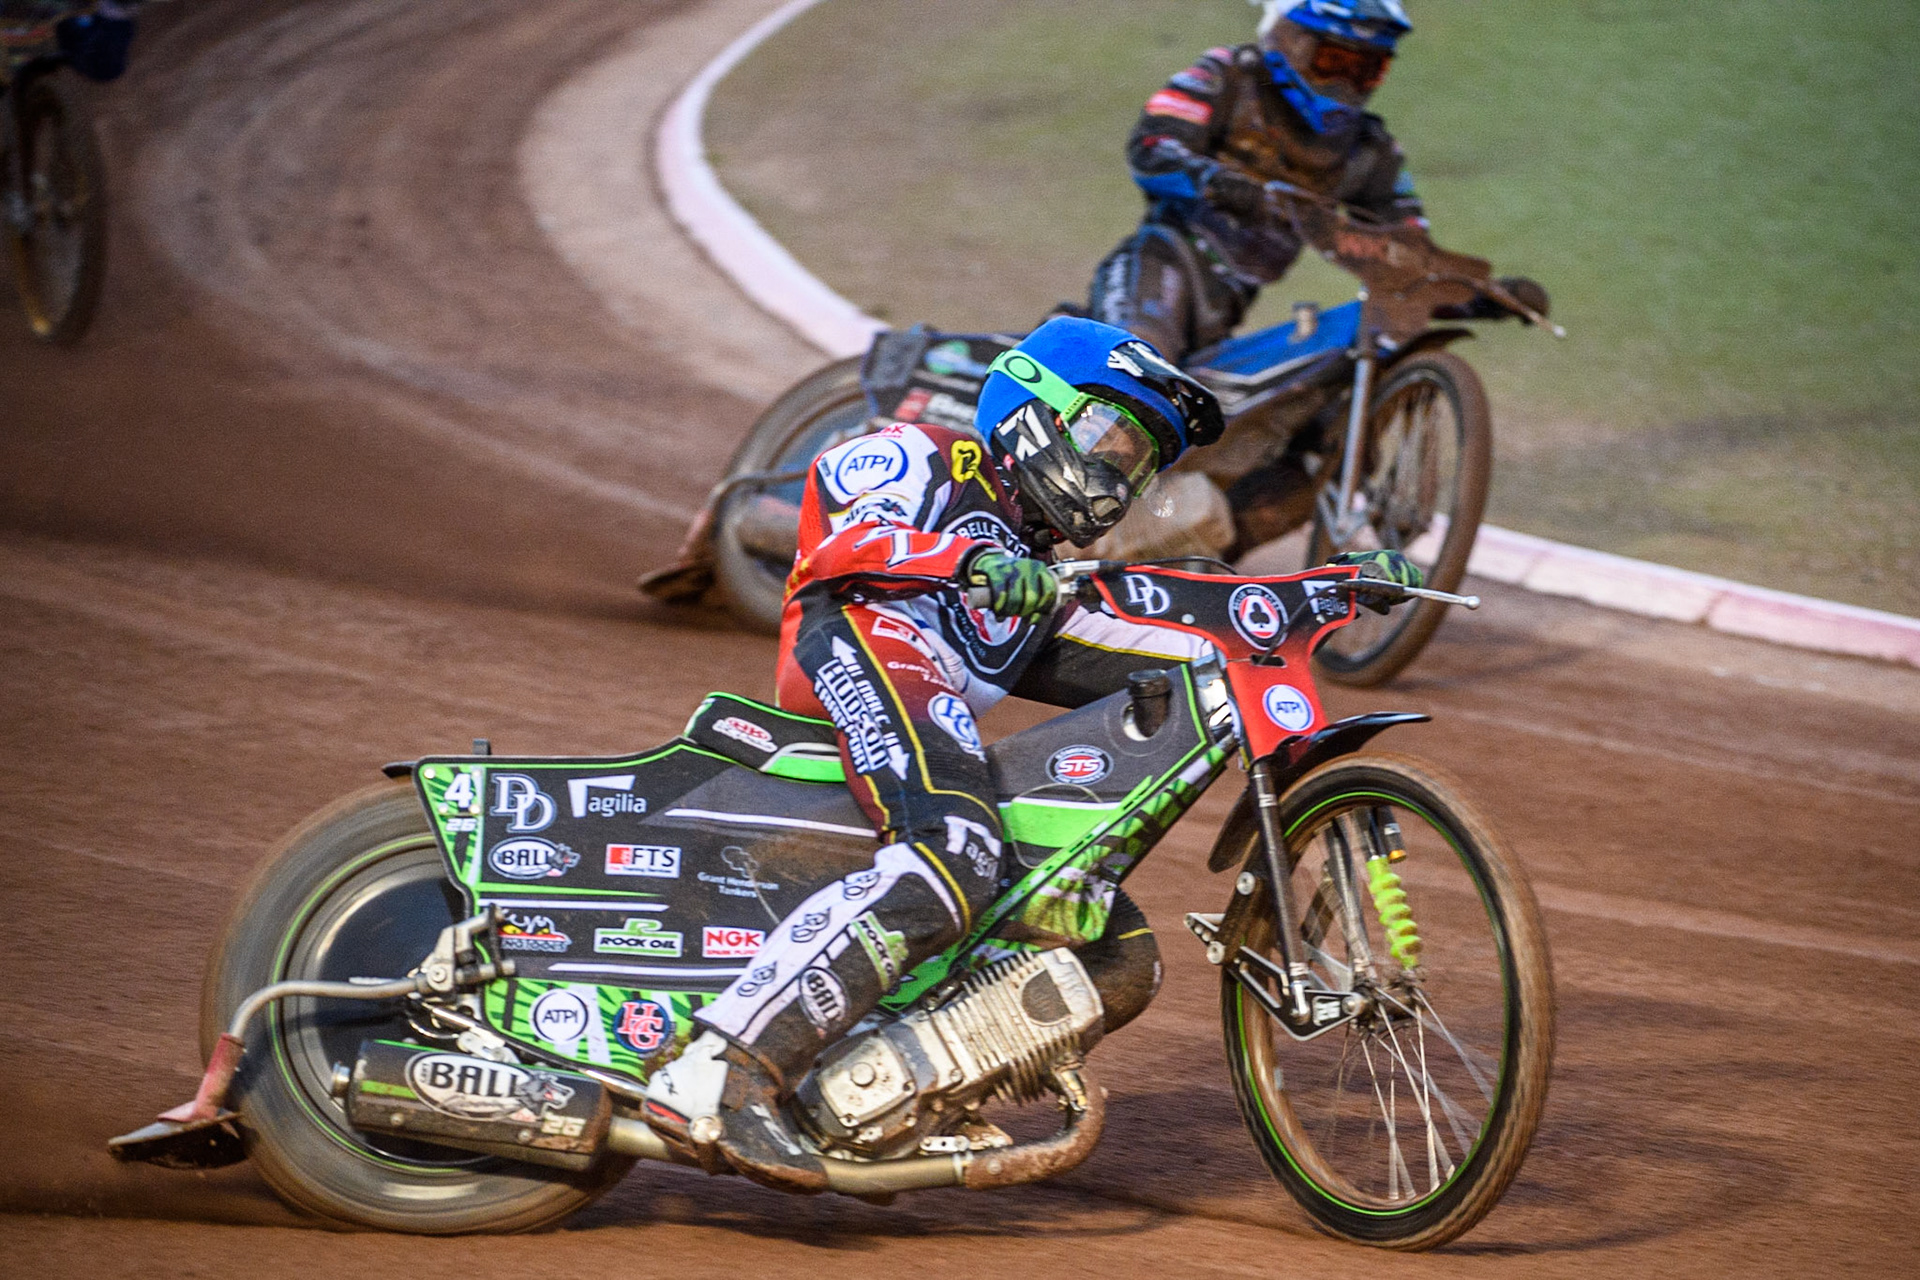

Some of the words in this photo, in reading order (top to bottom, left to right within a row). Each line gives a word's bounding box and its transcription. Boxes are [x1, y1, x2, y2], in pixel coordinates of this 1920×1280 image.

[844, 454, 894, 476] ATPI
[956, 521, 1000, 539] BELLE
[1275, 701, 1304, 715] ATPI
[1057, 759, 1101, 774] STS
[444, 773, 474, 808] 4
[587, 793, 647, 818] agilia
[631, 847, 675, 867] FTS
[600, 936, 647, 947] ROCK
[649, 939, 676, 949] OIL
[706, 930, 761, 947] NGK
[541, 1009, 578, 1024] ATPI
